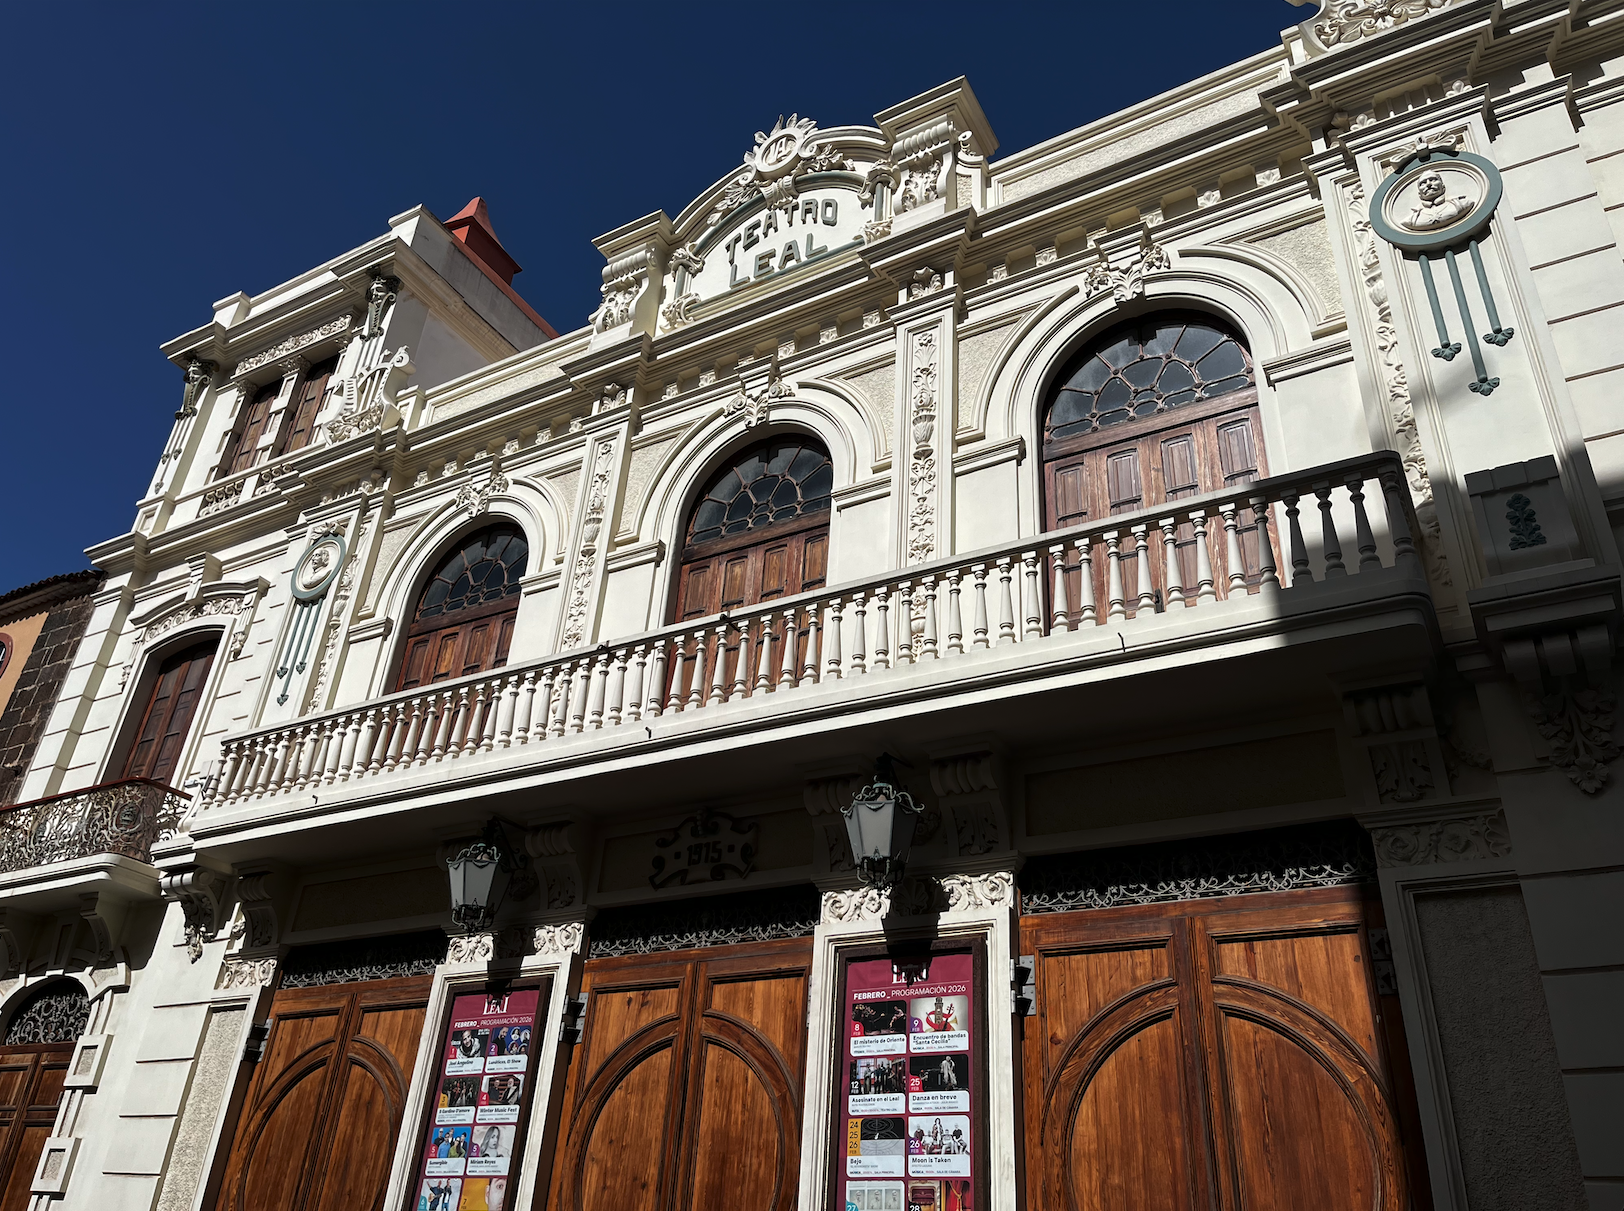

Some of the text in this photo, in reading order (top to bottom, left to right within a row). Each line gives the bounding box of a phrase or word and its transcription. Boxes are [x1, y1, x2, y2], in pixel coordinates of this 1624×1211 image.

[725, 198, 838, 265] TEATRO
[729, 232, 828, 289] LEAL
[687, 841, 722, 866] 1915
[892, 986, 947, 997] PROGRAMACIÓN
[948, 985, 966, 993] 2026
[480, 1017, 518, 1026] PROGRAMACIÓN
[851, 1081, 859, 1089] 12
[910, 1078, 920, 1086] 25
[849, 1121, 858, 1129] 24
[849, 1131, 858, 1139] 25
[849, 1141, 858, 1149] 26
[909, 1140, 920, 1148] 26
